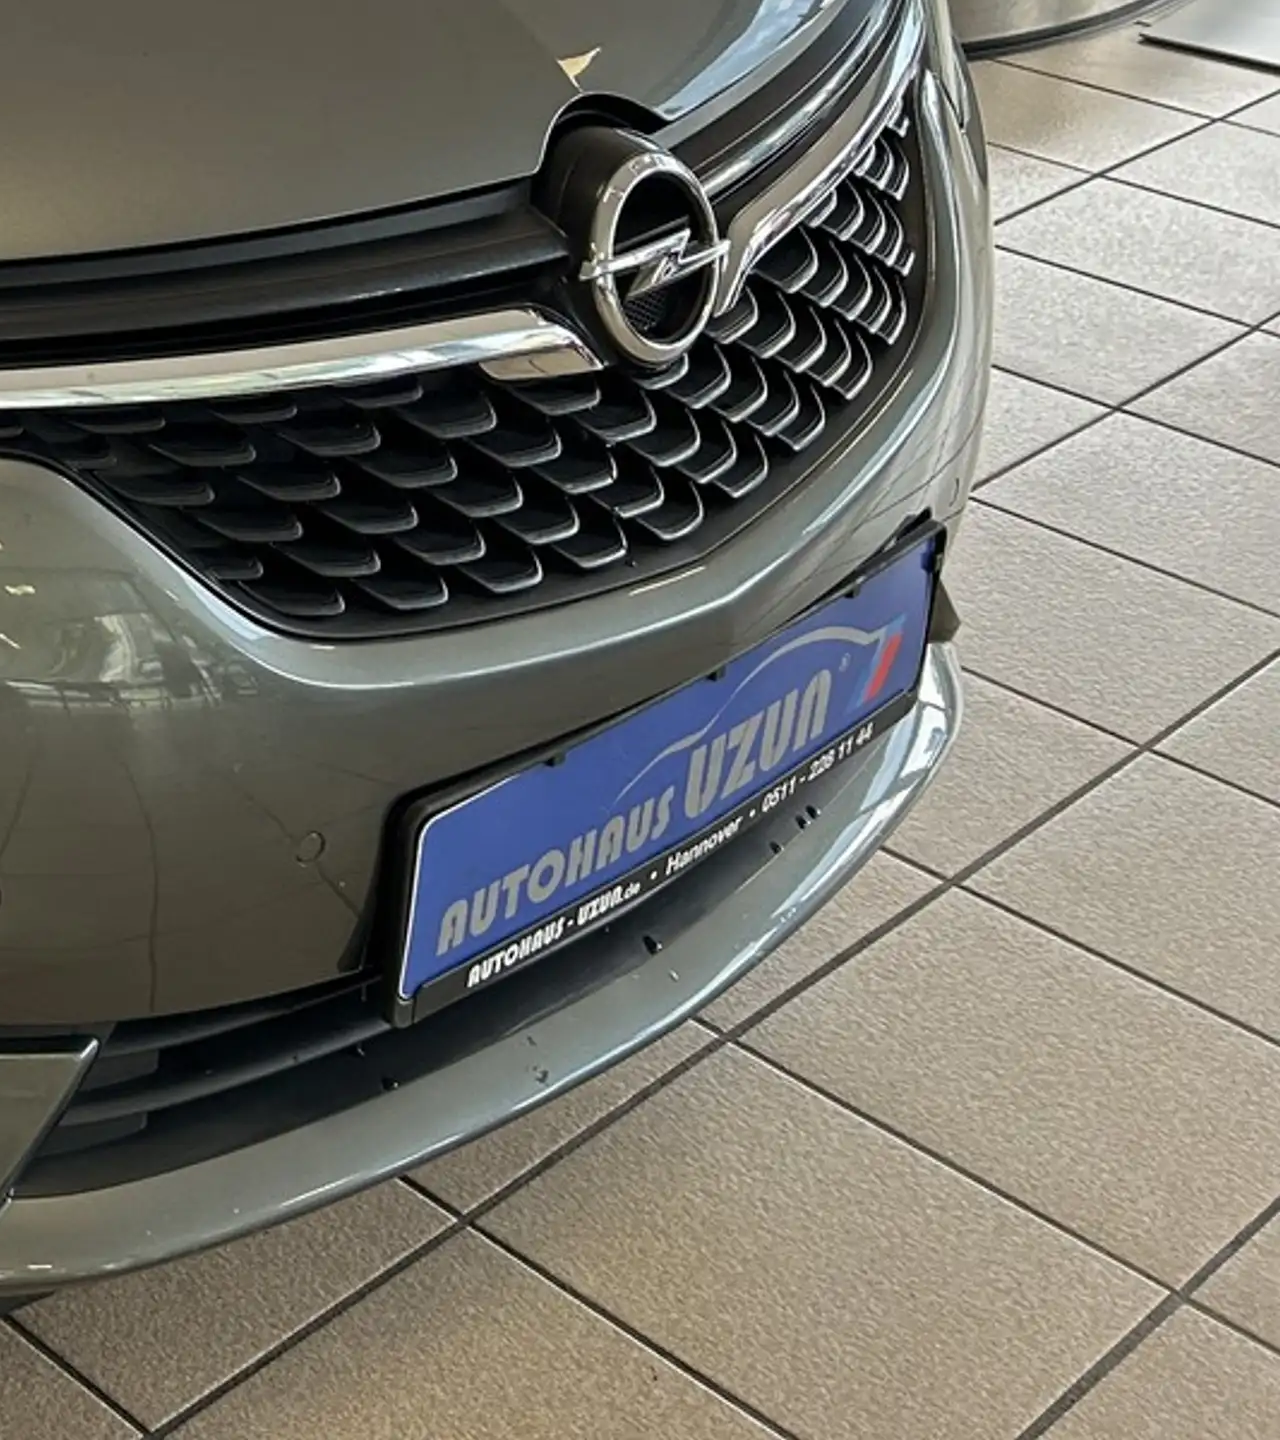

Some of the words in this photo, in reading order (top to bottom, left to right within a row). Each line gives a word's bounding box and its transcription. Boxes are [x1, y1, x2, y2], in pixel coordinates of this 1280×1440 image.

[436, 785, 676, 956] AUTOHAUS
[683, 668, 832, 817] UZUN
[665, 815, 744, 876] Hannover
[761, 775, 797, 812] 0511
[807, 749, 835, 781] 228
[837, 735, 855, 760] 11
[855, 722, 874, 746] 44
